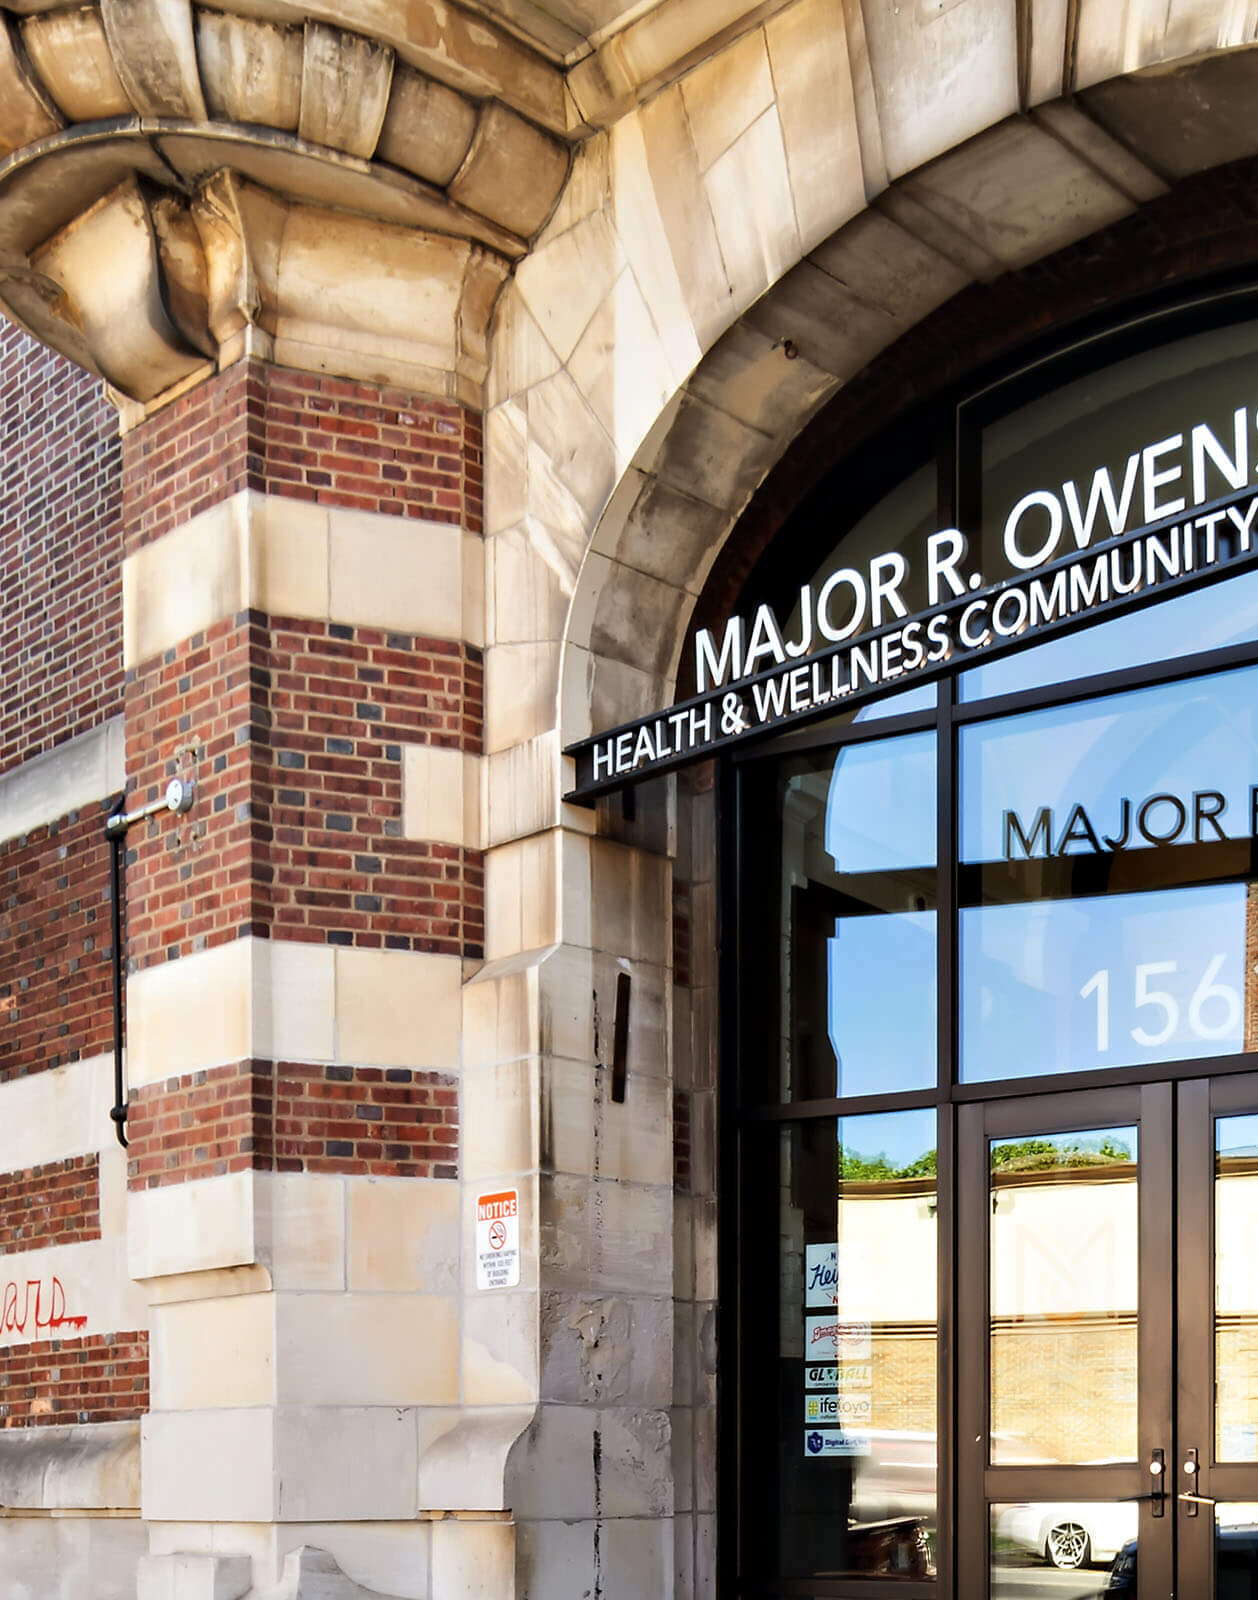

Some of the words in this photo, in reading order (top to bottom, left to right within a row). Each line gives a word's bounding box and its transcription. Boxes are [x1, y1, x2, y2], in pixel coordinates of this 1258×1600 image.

[695, 552, 909, 693] MAJOR
[928, 528, 982, 606] R.
[592, 708, 712, 780] HEALTH
[720, 692, 748, 734] &
[752, 614, 950, 723] WELLNESS
[1004, 792, 1229, 859] MAJOR
[479, 1199, 517, 1221] NOTICE
